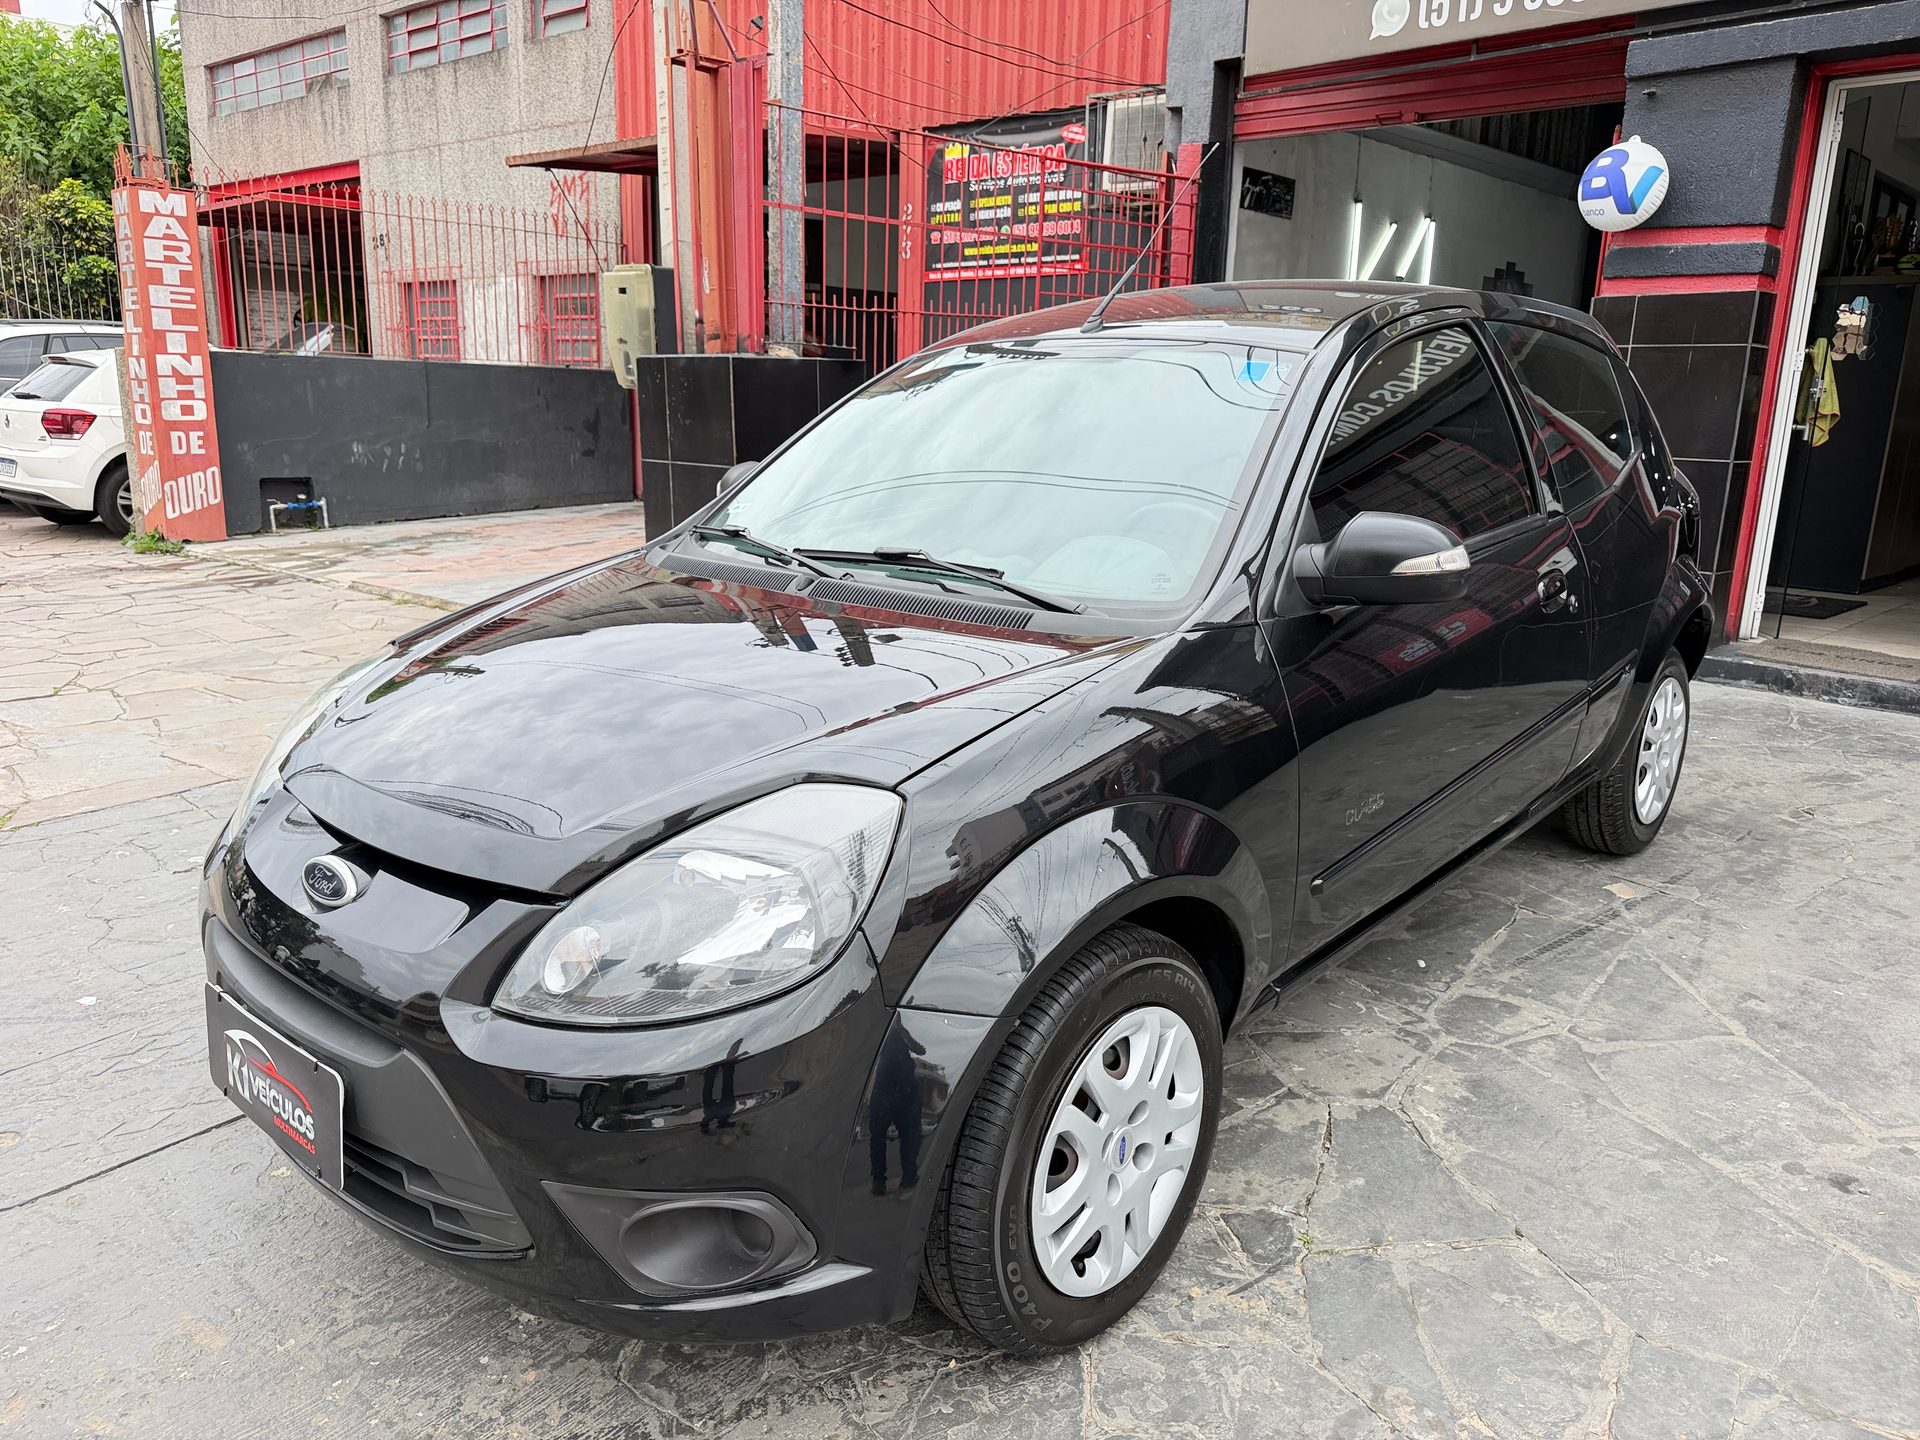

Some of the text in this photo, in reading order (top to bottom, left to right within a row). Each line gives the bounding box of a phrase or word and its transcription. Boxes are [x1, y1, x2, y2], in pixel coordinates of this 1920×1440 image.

[969, 153, 990, 180] DA
[1581, 148, 1664, 214] BV
[114, 189, 153, 425] MARTELINHO
[138, 189, 208, 422] MARTELINHO
[139, 430, 154, 455] DE
[170, 431, 206, 455] DE
[141, 460, 162, 515] OURO
[164, 465, 221, 520] OURO
[309, 865, 337, 895] Ford
[249, 1069, 315, 1140] VEÍCULOS
[273, 1115, 316, 1155] MULTIMARCAS
